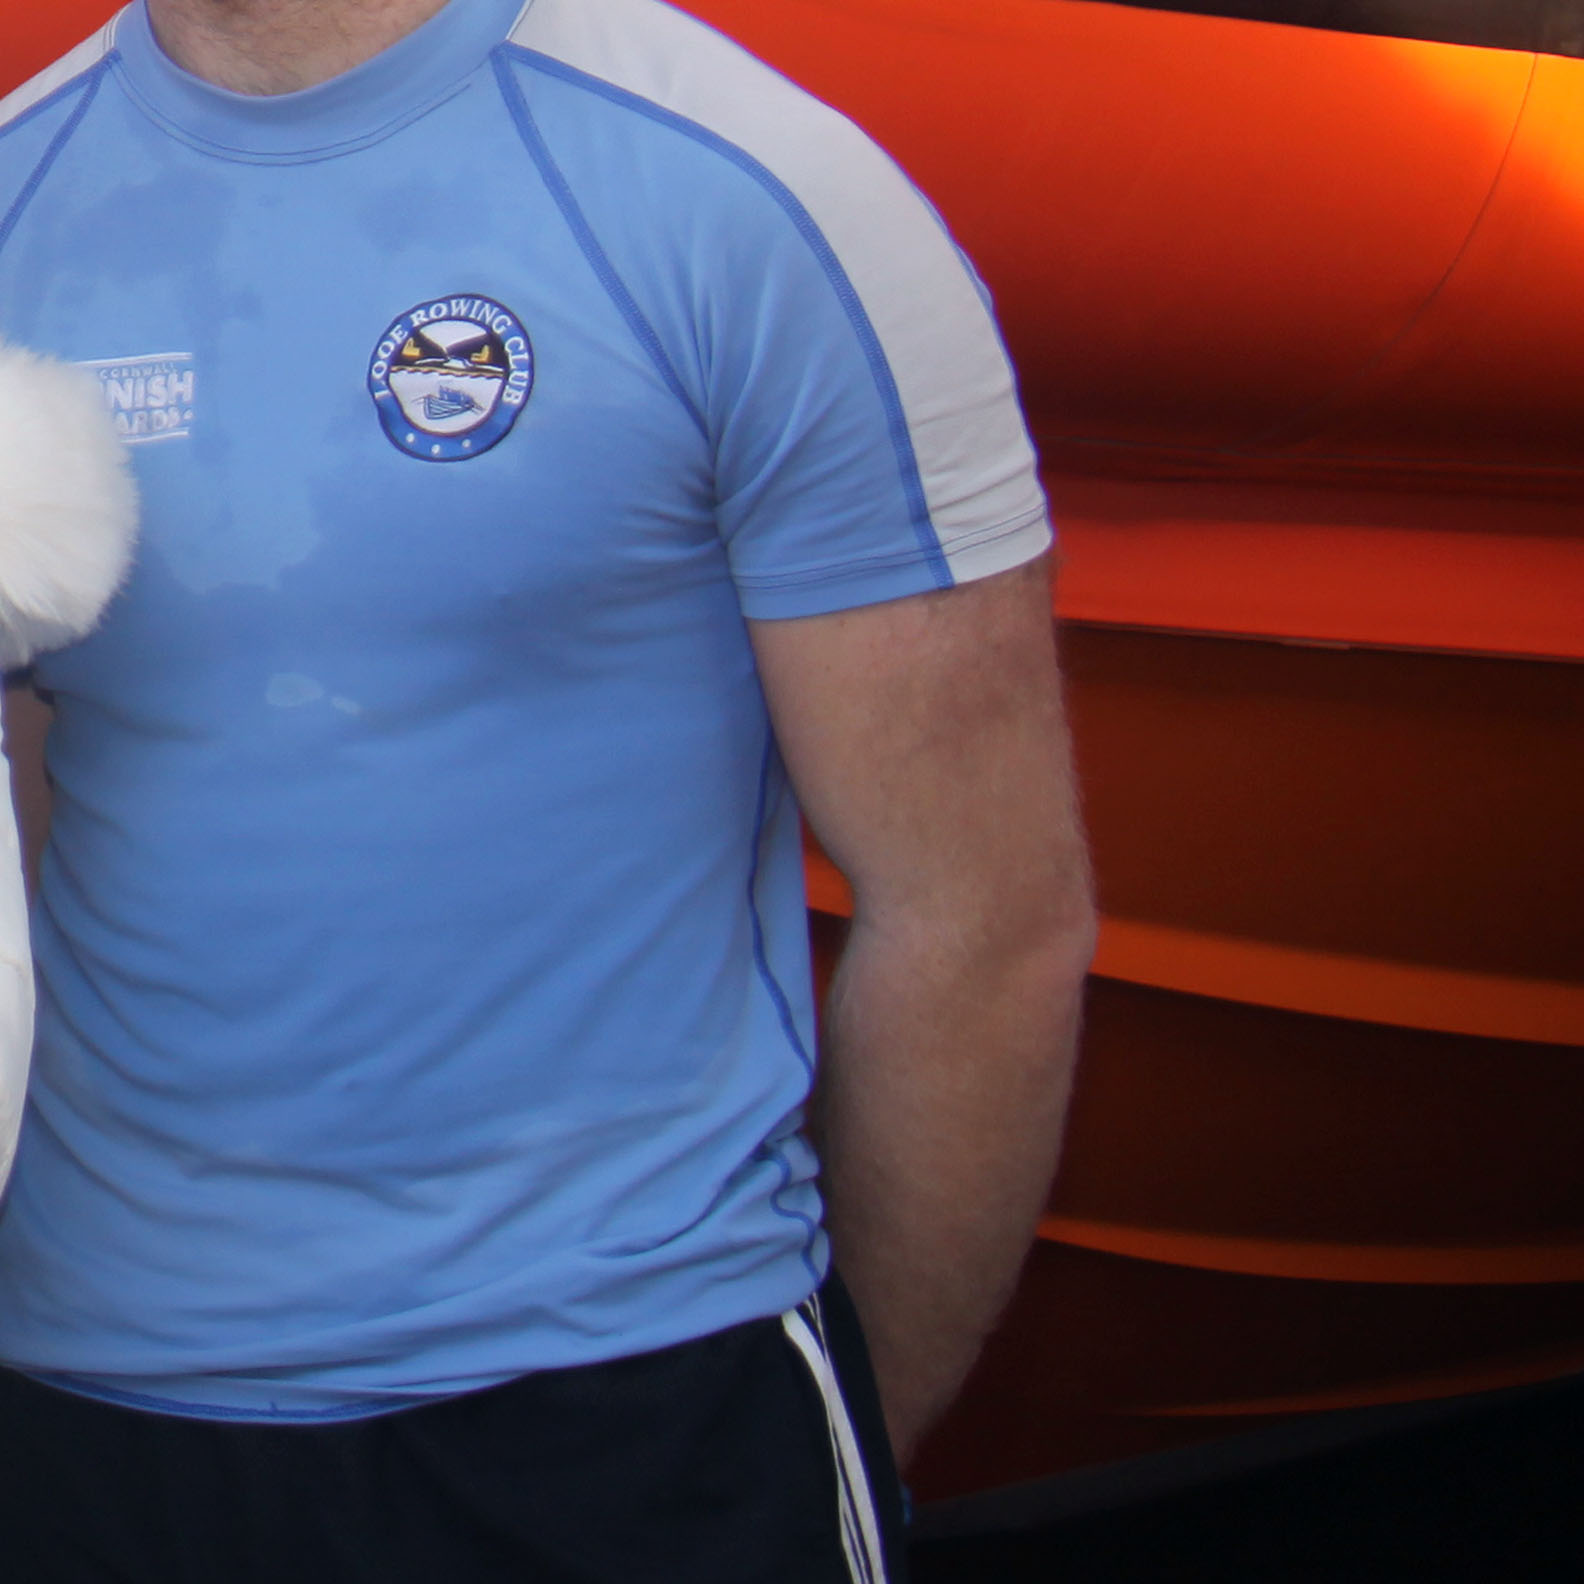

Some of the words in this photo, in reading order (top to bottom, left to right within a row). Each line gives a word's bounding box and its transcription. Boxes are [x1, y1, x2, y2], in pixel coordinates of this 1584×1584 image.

[372, 324, 408, 399] LOOE
[410, 299, 511, 334] ROWING
[502, 336, 530, 404] CLUB
[100, 370, 194, 409] NISH
